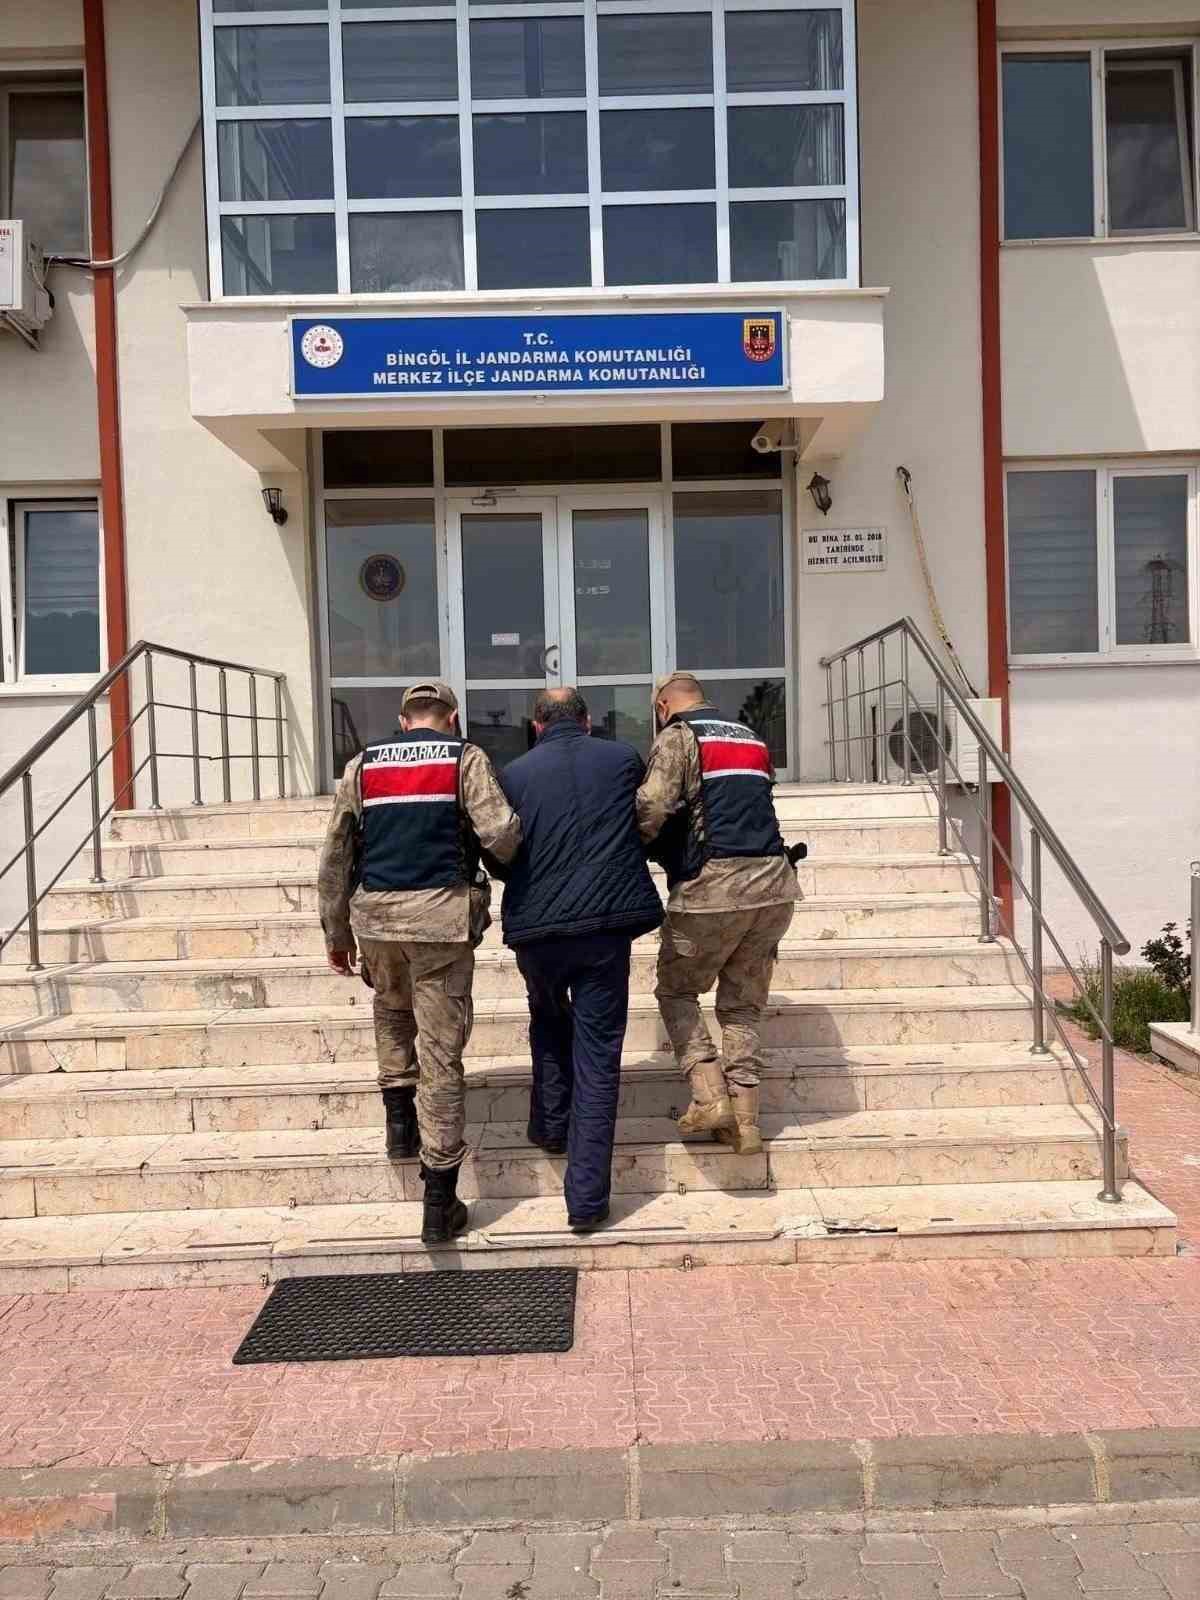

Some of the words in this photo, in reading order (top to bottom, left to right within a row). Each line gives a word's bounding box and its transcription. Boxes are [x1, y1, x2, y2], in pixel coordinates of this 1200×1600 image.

[523, 333, 554, 346] T.C.
[387, 349, 451, 367] BİNGÖL
[456, 349, 472, 365] İL
[476, 351, 570, 366] JANDARMA
[575, 345, 694, 363] KOMUTANLIĞI
[373, 372, 444, 386] MERKEZ
[448, 368, 487, 388] İLÇE
[491, 370, 584, 384] JANDARMA
[589, 364, 708, 382] KOMUTANLIĞI
[373, 745, 450, 763] JANDARMA
